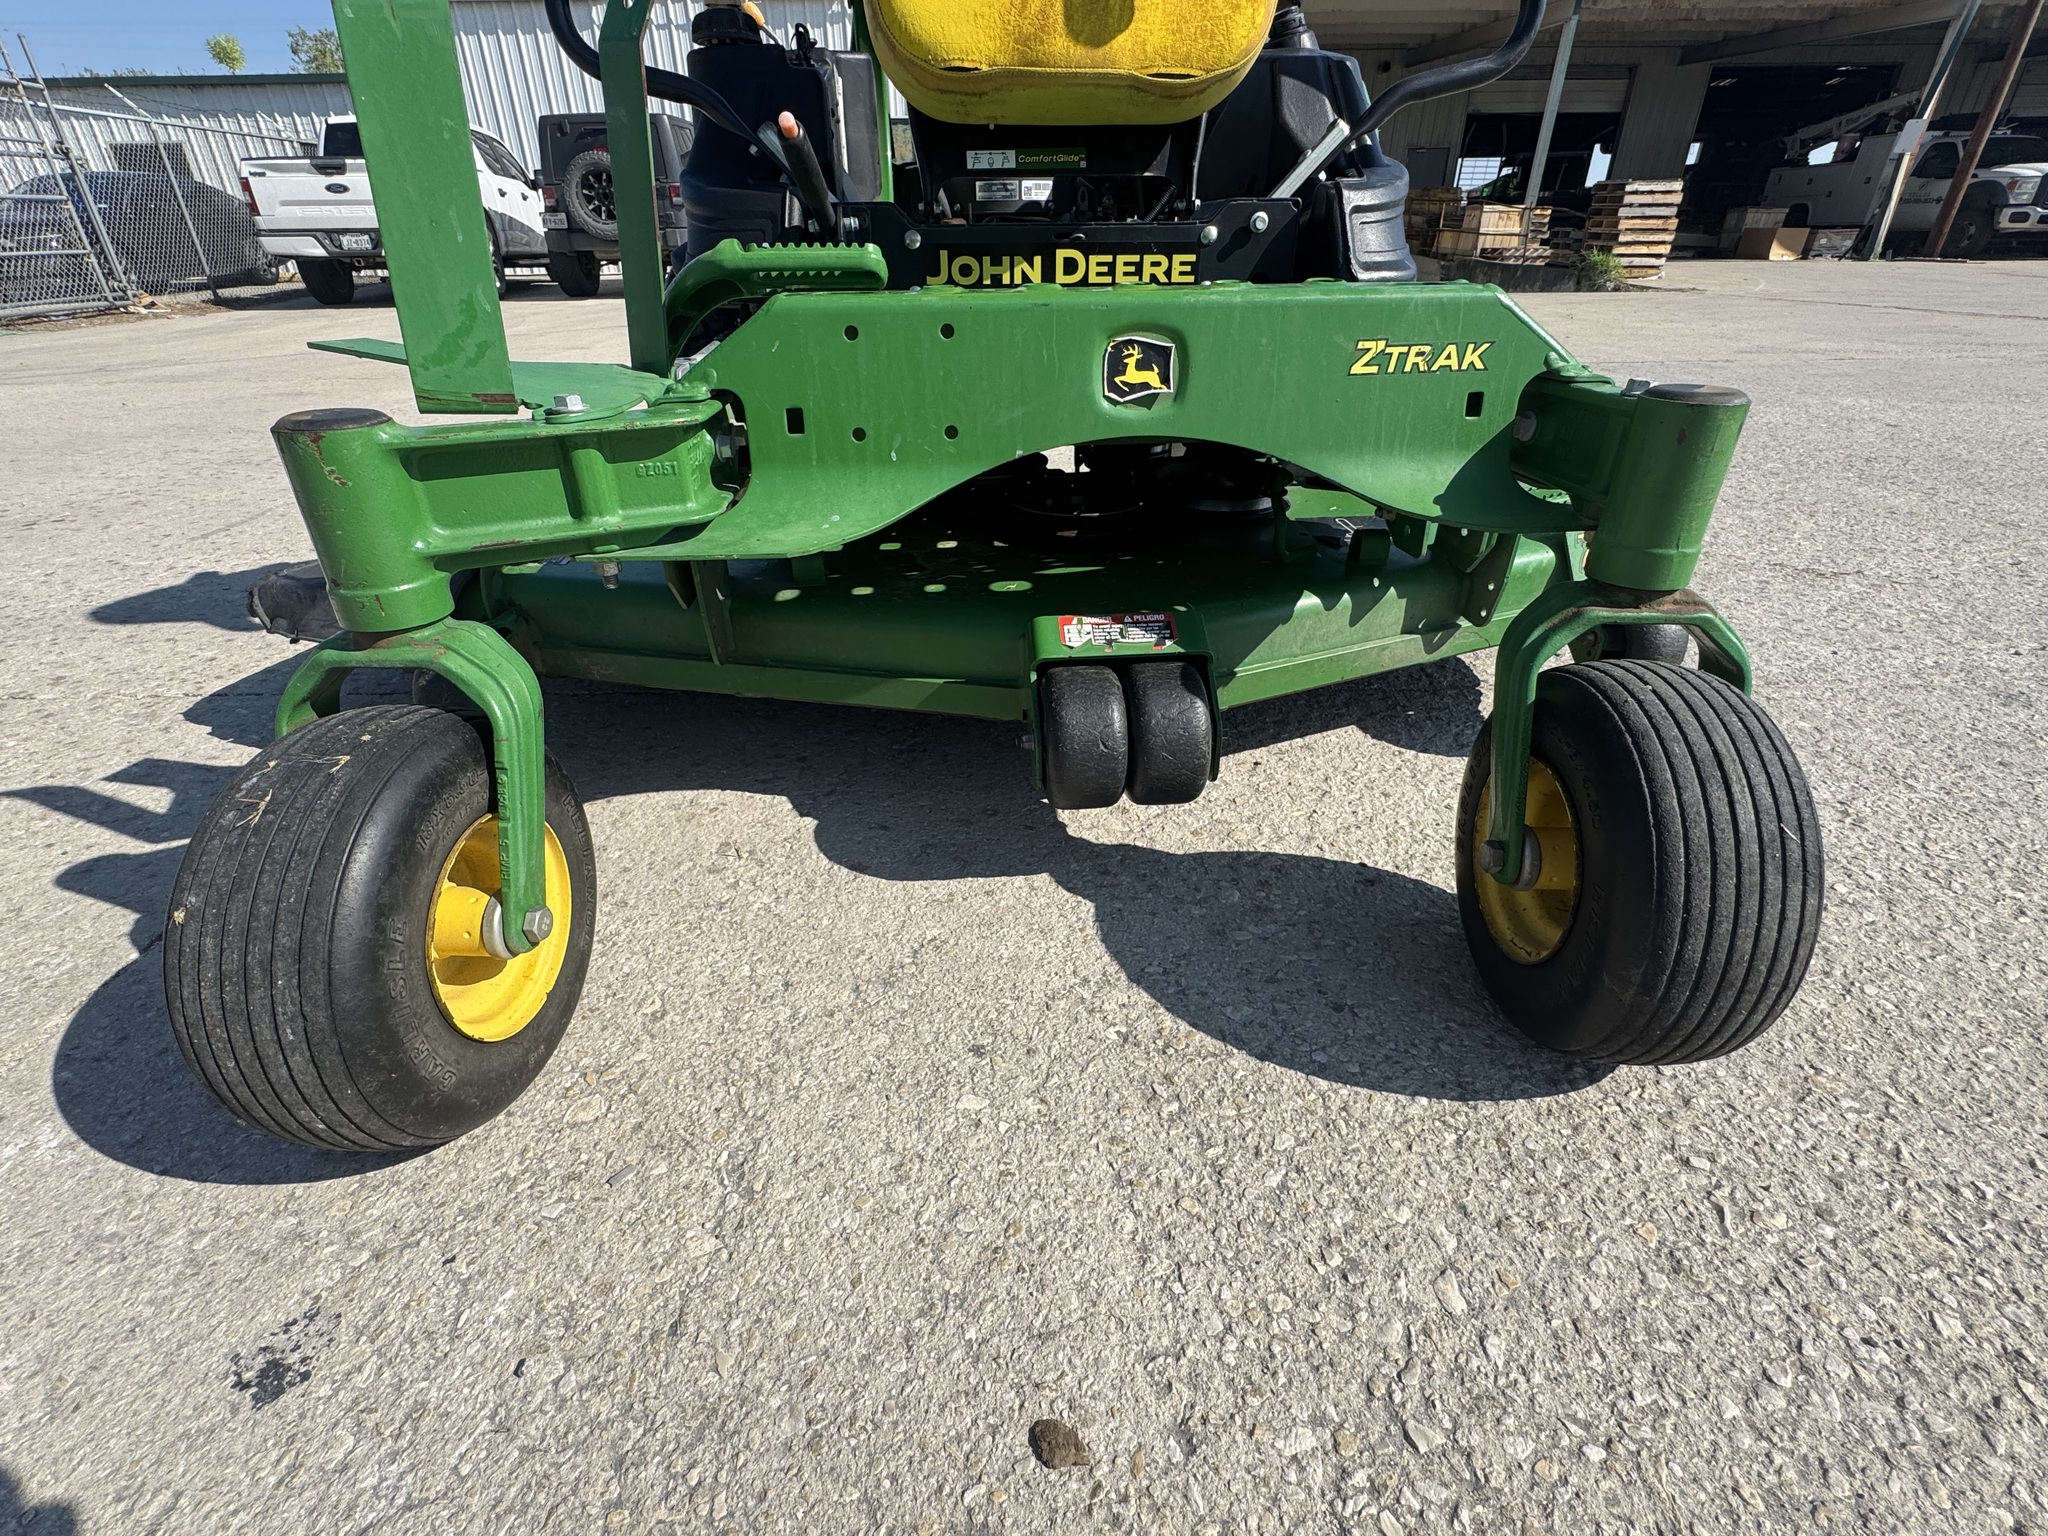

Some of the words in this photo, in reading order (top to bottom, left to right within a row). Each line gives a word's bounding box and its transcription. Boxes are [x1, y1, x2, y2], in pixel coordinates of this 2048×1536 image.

[926, 250, 1042, 285] JOHN
[1055, 248, 1197, 284] DEERE
[1348, 338, 1496, 376] ZTRAK
[1133, 614, 1165, 622] PELIGRO
[386, 918, 460, 1094] CARLISLE
